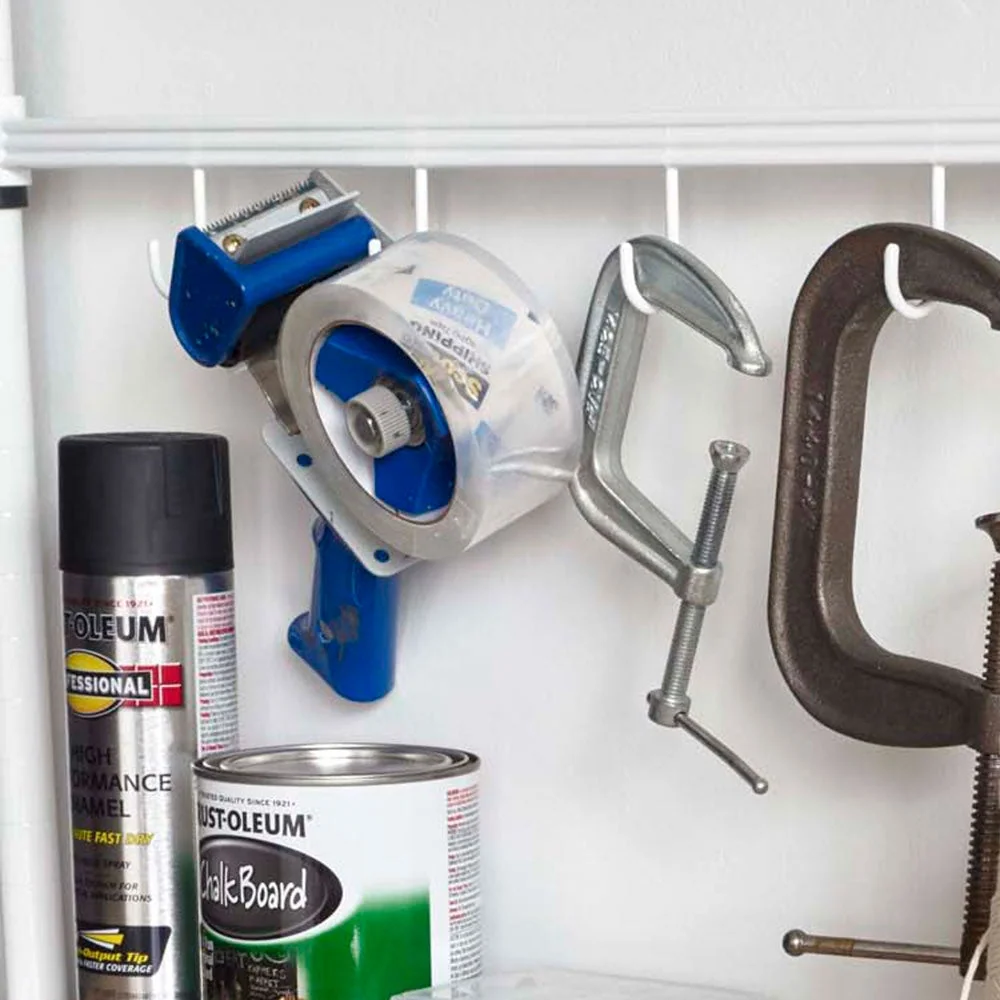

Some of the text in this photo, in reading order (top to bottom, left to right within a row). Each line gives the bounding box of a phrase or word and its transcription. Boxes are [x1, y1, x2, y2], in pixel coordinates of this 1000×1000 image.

[218, 794, 244, 805] QUALITY
[247, 798, 271, 807] SINCE
[94, 831, 121, 845] FAST
[126, 951, 149, 964] Tip
[106, 962, 153, 973] COVERAGE
